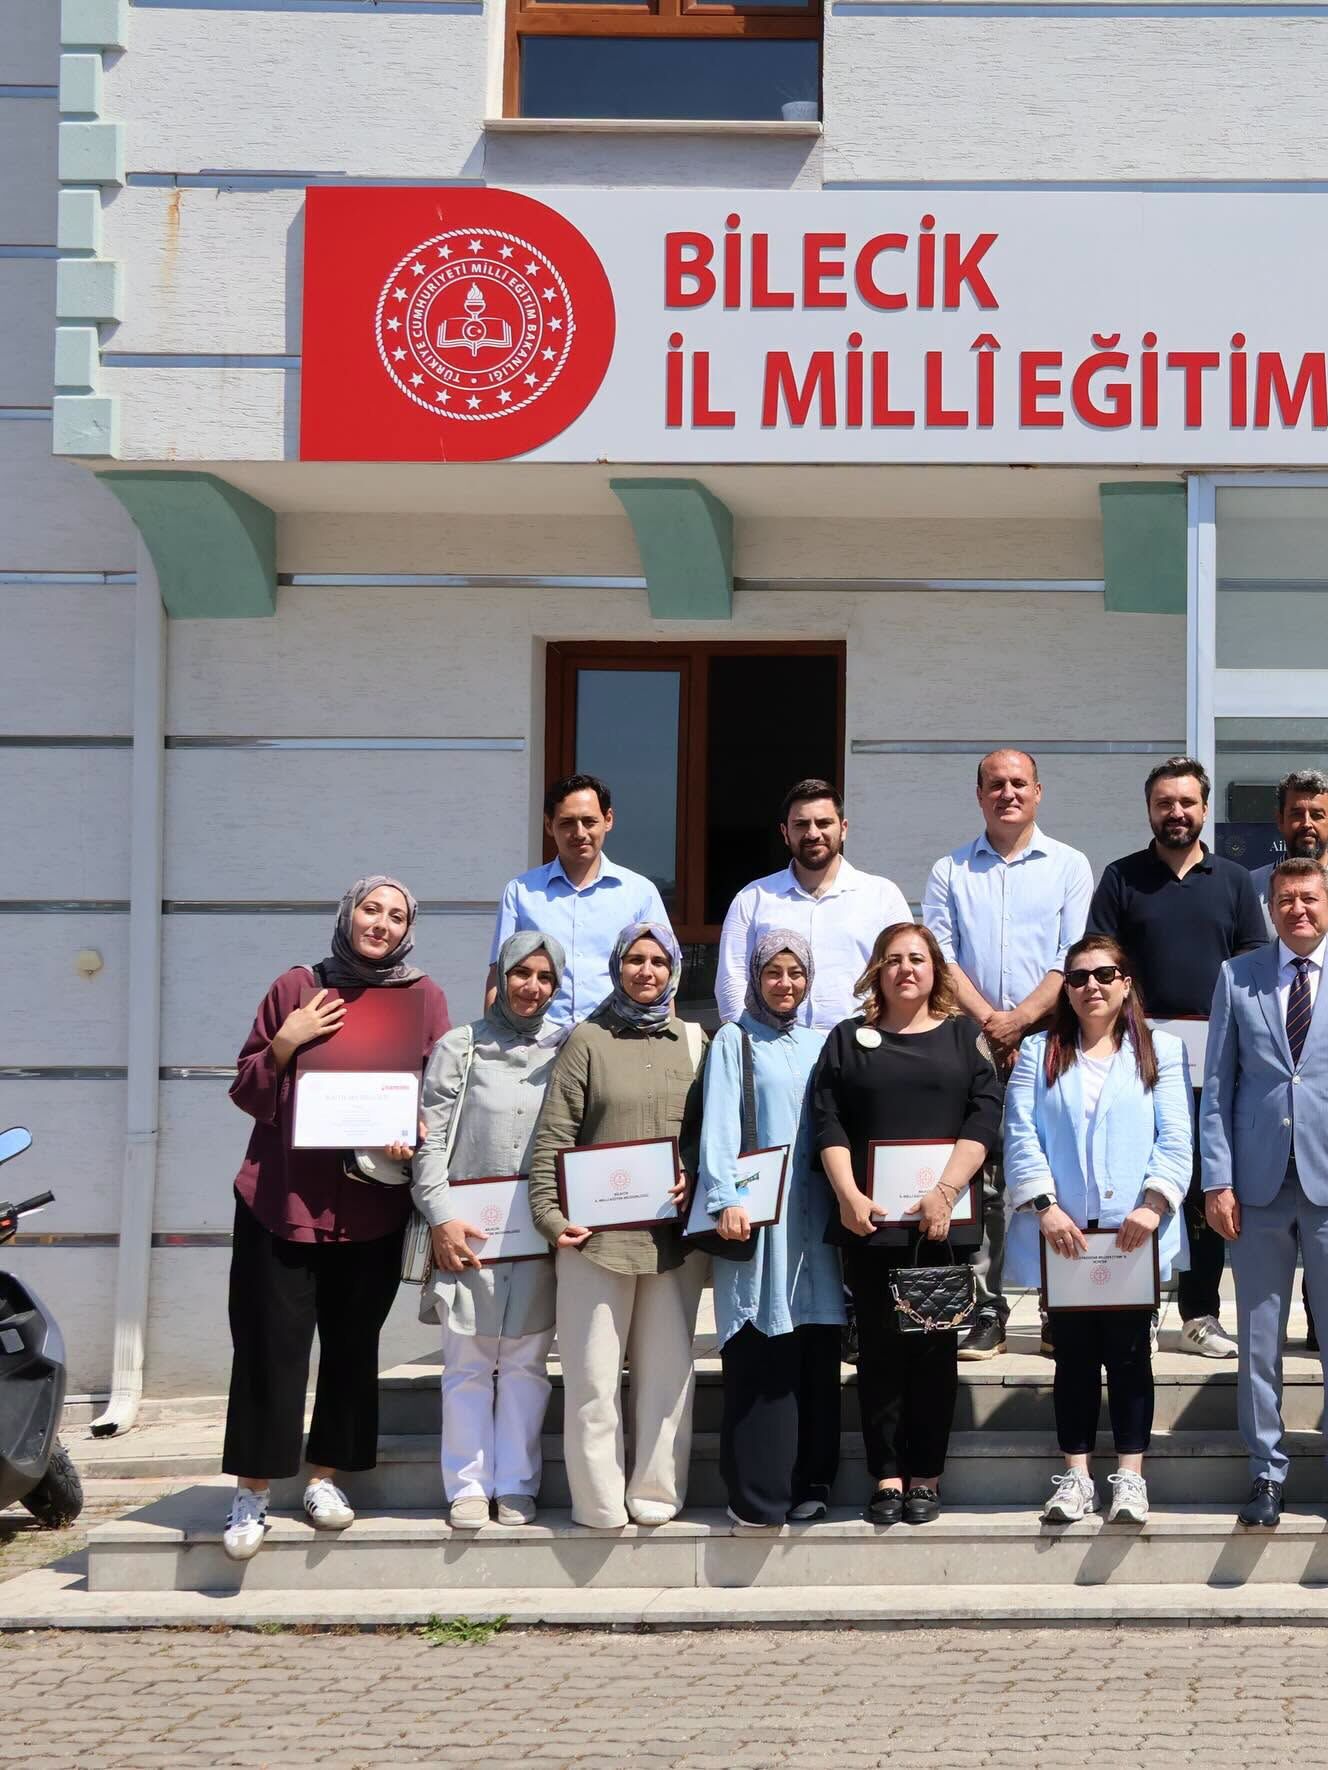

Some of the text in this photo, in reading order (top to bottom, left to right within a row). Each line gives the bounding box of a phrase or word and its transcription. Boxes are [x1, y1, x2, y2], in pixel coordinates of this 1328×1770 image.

[664, 213, 1000, 311] BİLECİK
[412, 262, 467, 338] CUMHURİYETİ
[508, 277, 537, 320] EĞİTİM
[415, 340, 461, 383] TÜRKİYE
[488, 323, 537, 382] BAKANLIĞI
[664, 331, 736, 428] İL
[760, 331, 1002, 429] MİLLÎ
[1018, 331, 1328, 430] EĞİTİM
